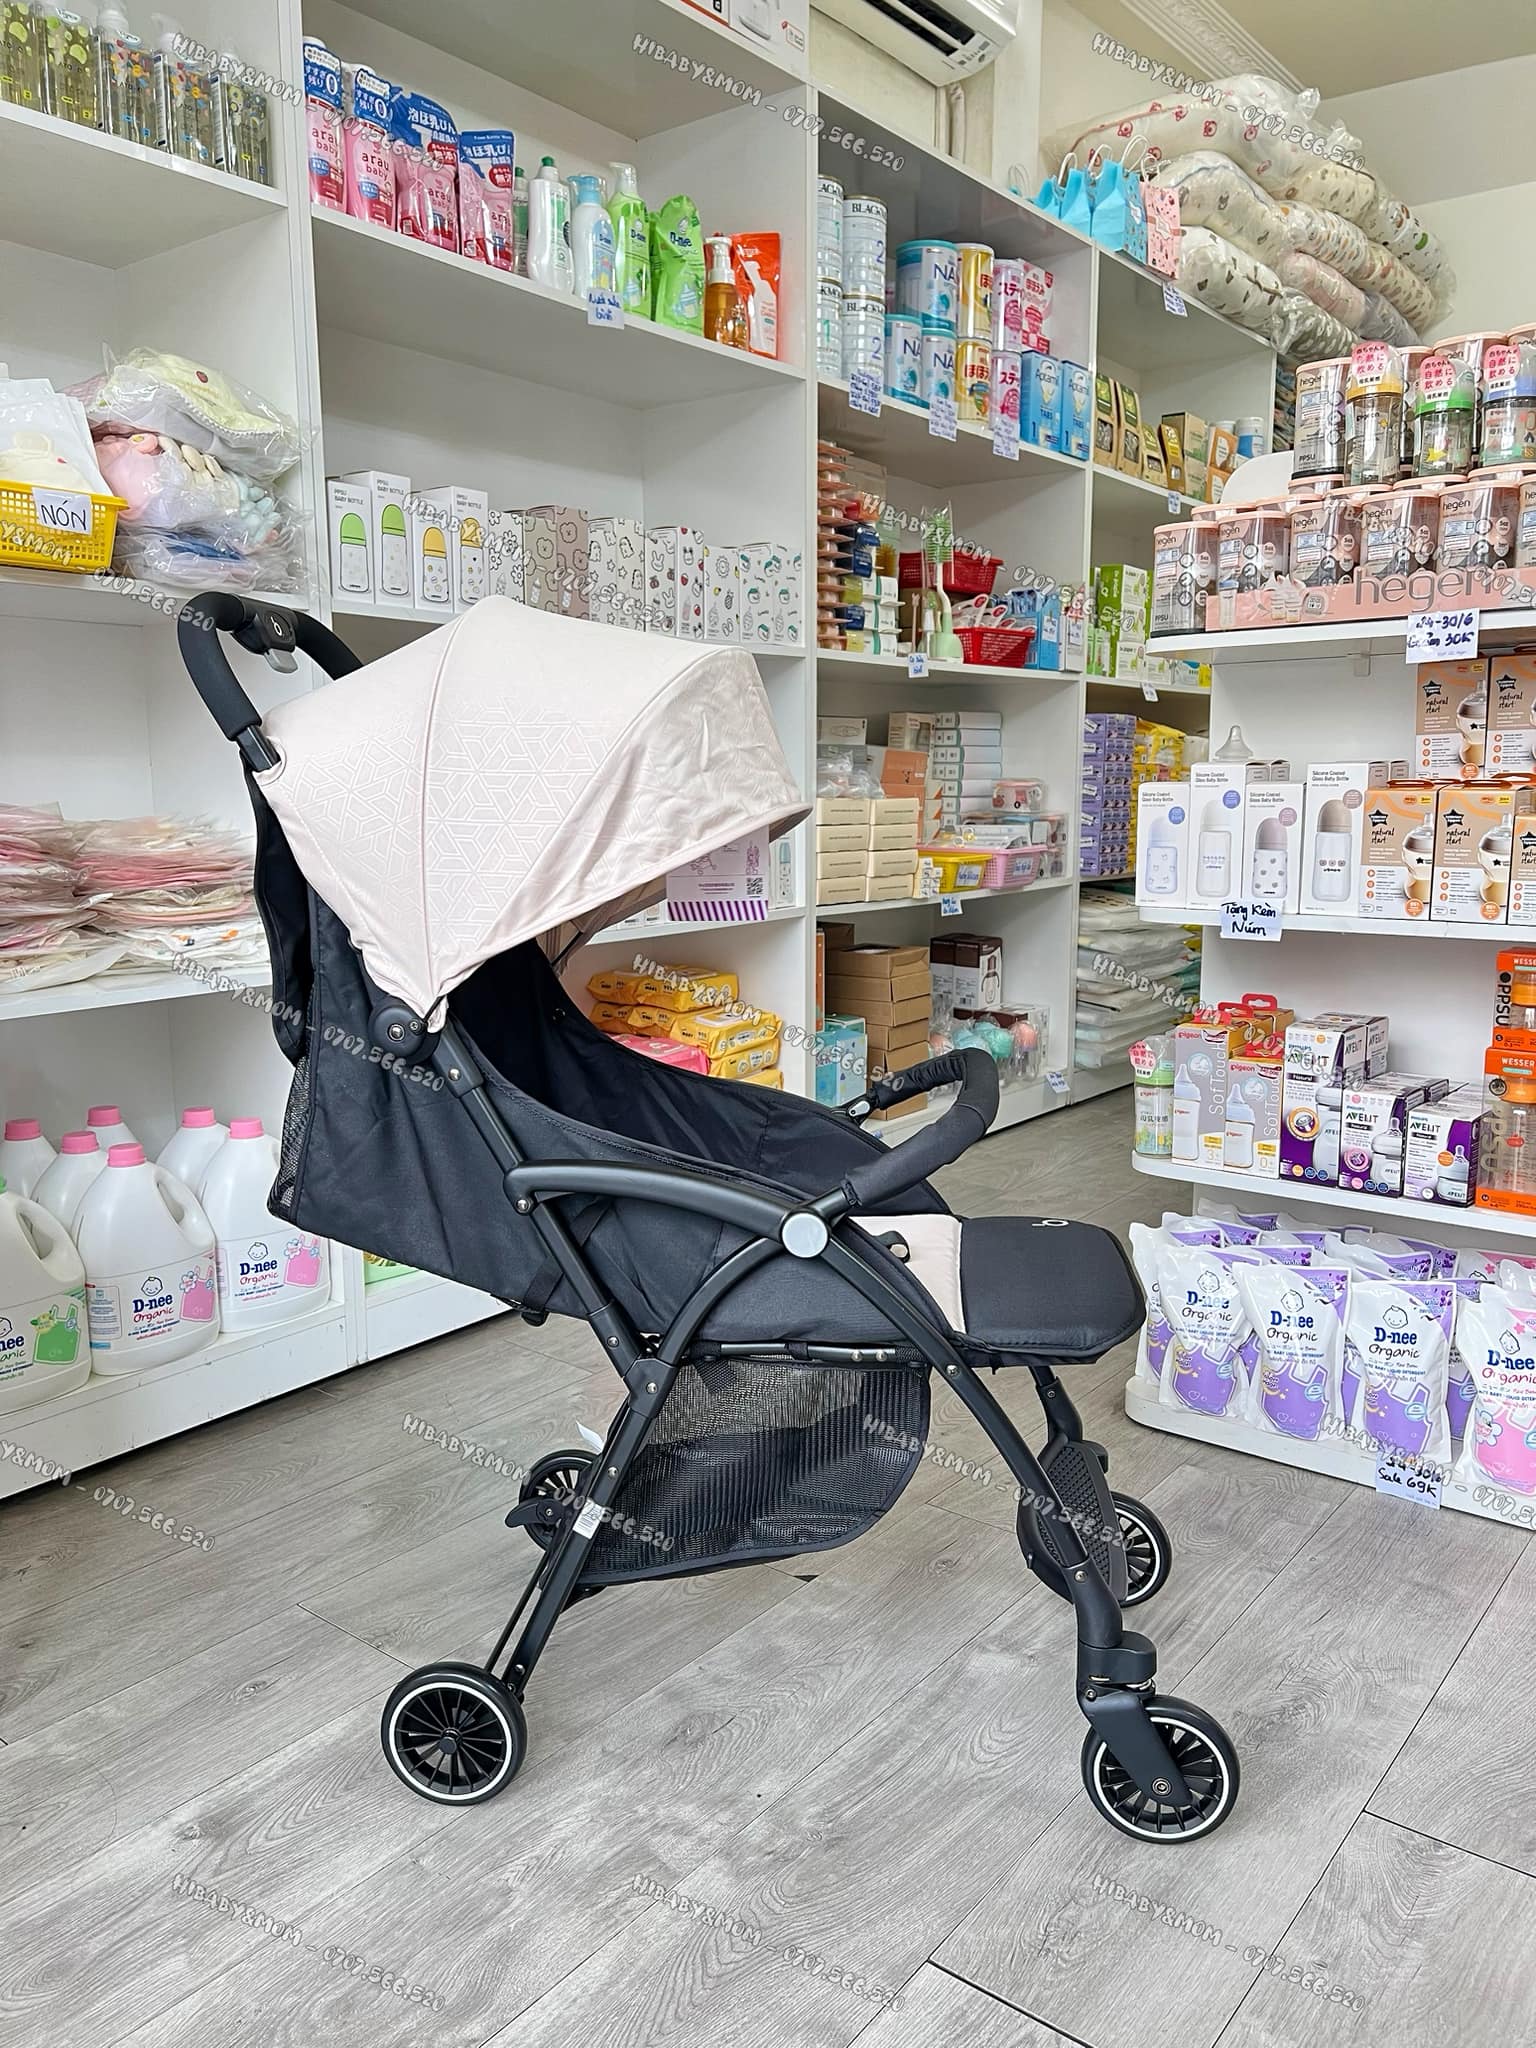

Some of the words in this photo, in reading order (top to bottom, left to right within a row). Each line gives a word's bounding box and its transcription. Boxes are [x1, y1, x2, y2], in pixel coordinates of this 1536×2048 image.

[362, 152, 389, 170] arau
[366, 165, 388, 181] baby
[876, 240, 885, 264] 2
[871, 336, 882, 360] 2
[1443, 499, 1470, 511] hegen
[41, 500, 87, 531] NÓN
[1293, 515, 1318, 528] hegen
[1366, 508, 1392, 520] hegen
[1355, 566, 1491, 613] hegen
[1426, 696, 1449, 706] natural
[1499, 691, 1523, 700] natural
[1426, 706, 1441, 714] start
[1371, 827, 1395, 836] natural
[1446, 827, 1472, 837] natural
[1371, 836, 1387, 844] start
[1446, 836, 1462, 845] start
[1251, 902, 1276, 918] Kèm
[1232, 920, 1267, 937] Núm
[1495, 984, 1511, 1026] PPSU
[1501, 1057, 1536, 1067] WESSER
[1345, 1111, 1379, 1124] AVENT
[1410, 1122, 1441, 1133] AVENT
[240, 1259, 278, 1276] D-nee
[240, 1271, 279, 1285] Organic
[132, 1294, 173, 1313] D-nee
[133, 1307, 174, 1323] Organic
[1374, 1327, 1417, 1345] D-nee
[1369, 1343, 1420, 1360] Organic
[1377, 1467, 1403, 1485] Sale
[1406, 1476, 1438, 1498] 69K
